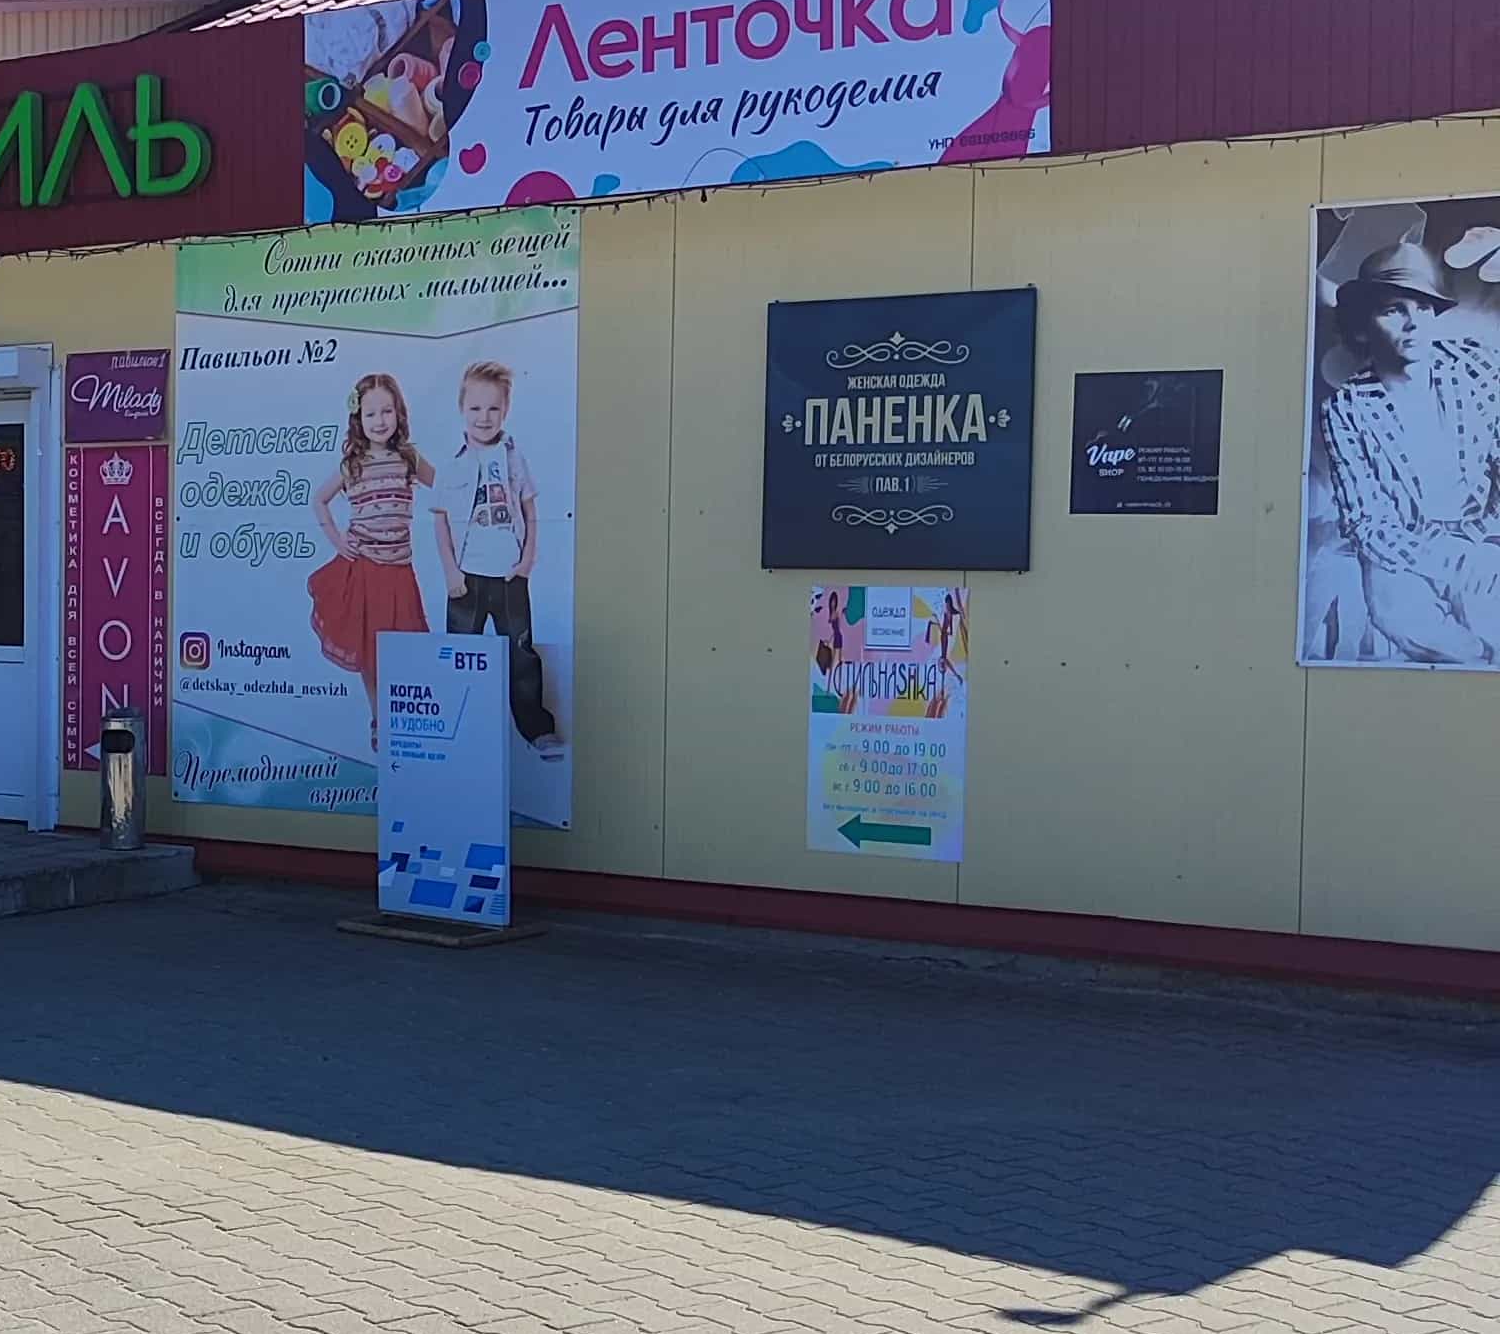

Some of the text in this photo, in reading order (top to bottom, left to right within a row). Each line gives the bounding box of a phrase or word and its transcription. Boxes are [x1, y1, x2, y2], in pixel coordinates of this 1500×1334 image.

[524, 69, 942, 150] Товары для рукоделия
[263, 223, 572, 276] Сотни сказочных вещей
[223, 264, 568, 316] для прекрасных малышей...
[179, 338, 338, 371] Павильон №2
[71, 374, 162, 416] Milady
[847, 372, 946, 391] ЖЕНСКАЯ ОДЕЖДА
[804, 393, 989, 446] ПАНЕНКА
[177, 421, 340, 464] Детская
[815, 448, 975, 468] ОТ БЕЛОРУССКИХ ДИЗАЙНЕРОВ
[1086, 443, 1136, 466] Vape
[180, 470, 311, 508] одежда
[179, 522, 315, 566] и обувь
[217, 639, 292, 666] Instagram
[454, 651, 488, 672] ВТБ
[179, 676, 349, 699] @detskay_odezhda_nesvizh
[389, 683, 433, 701] КОГДА
[389, 700, 440, 716] ПРОСТО
[390, 716, 446, 733] И УДОБНО
[173, 750, 339, 792] Перемодничай
